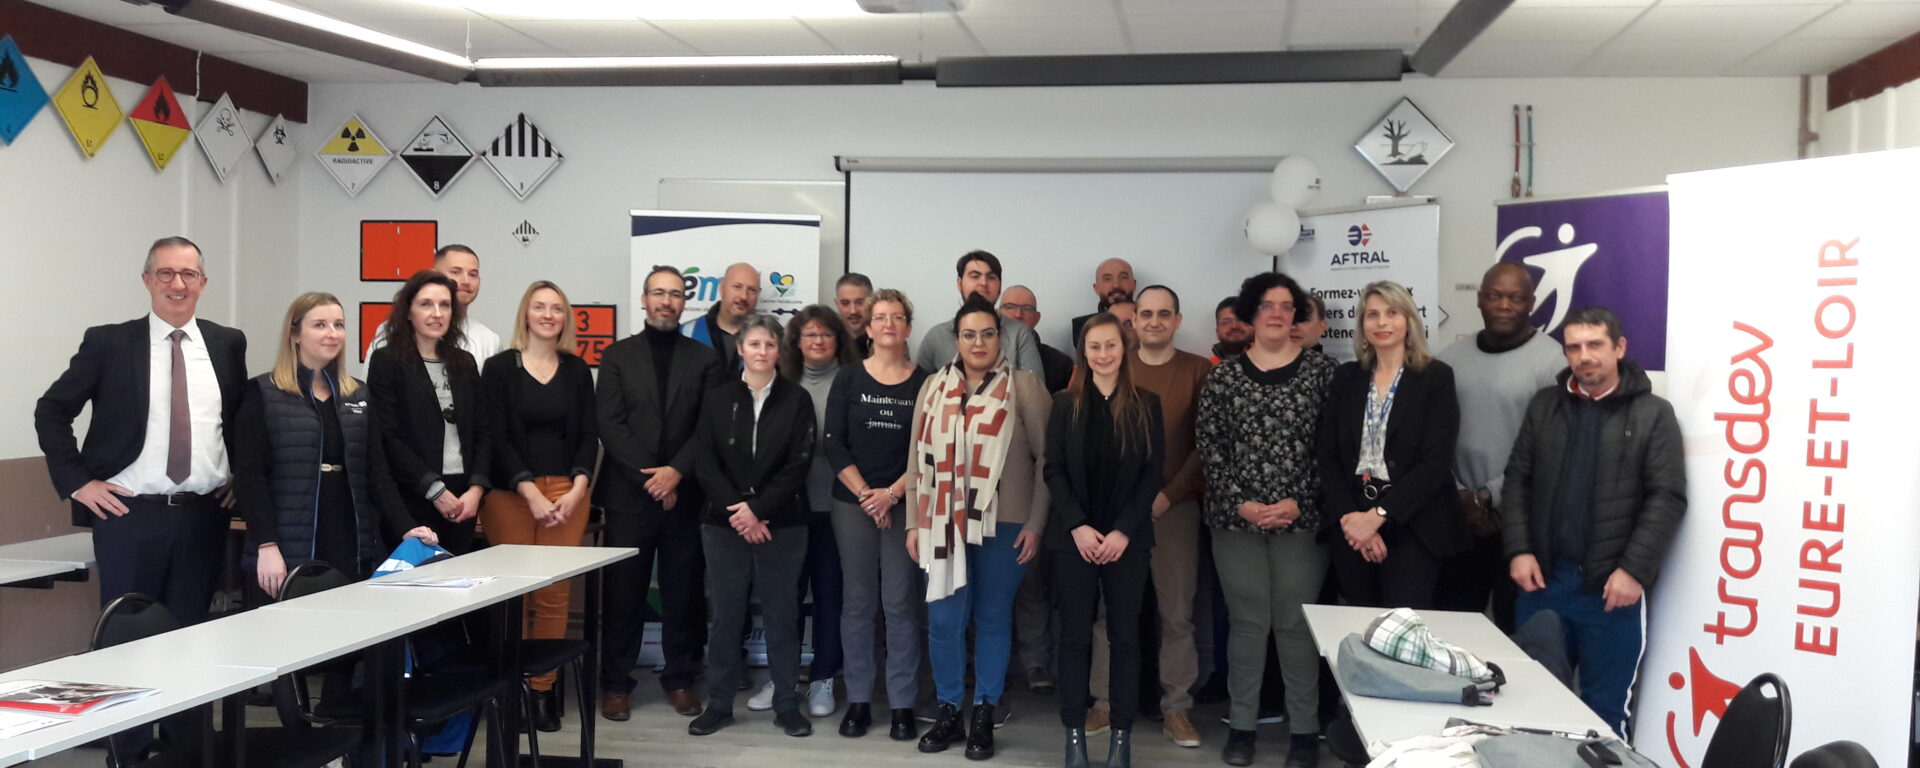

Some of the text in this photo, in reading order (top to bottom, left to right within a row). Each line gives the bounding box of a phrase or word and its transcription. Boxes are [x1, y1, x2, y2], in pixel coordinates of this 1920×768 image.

[332, 157, 373, 165] RADIOACTIVE
[433, 181, 440, 190] 8
[1330, 251, 1389, 265] AFTRAL
[577, 310, 590, 332] 3
[576, 340, 605, 362] 75
[860, 393, 915, 406] Maintenant
[866, 417, 903, 429] jamais
[1794, 236, 1860, 656] EURE-ET-LOIR
[1703, 320, 1774, 645] transdev
